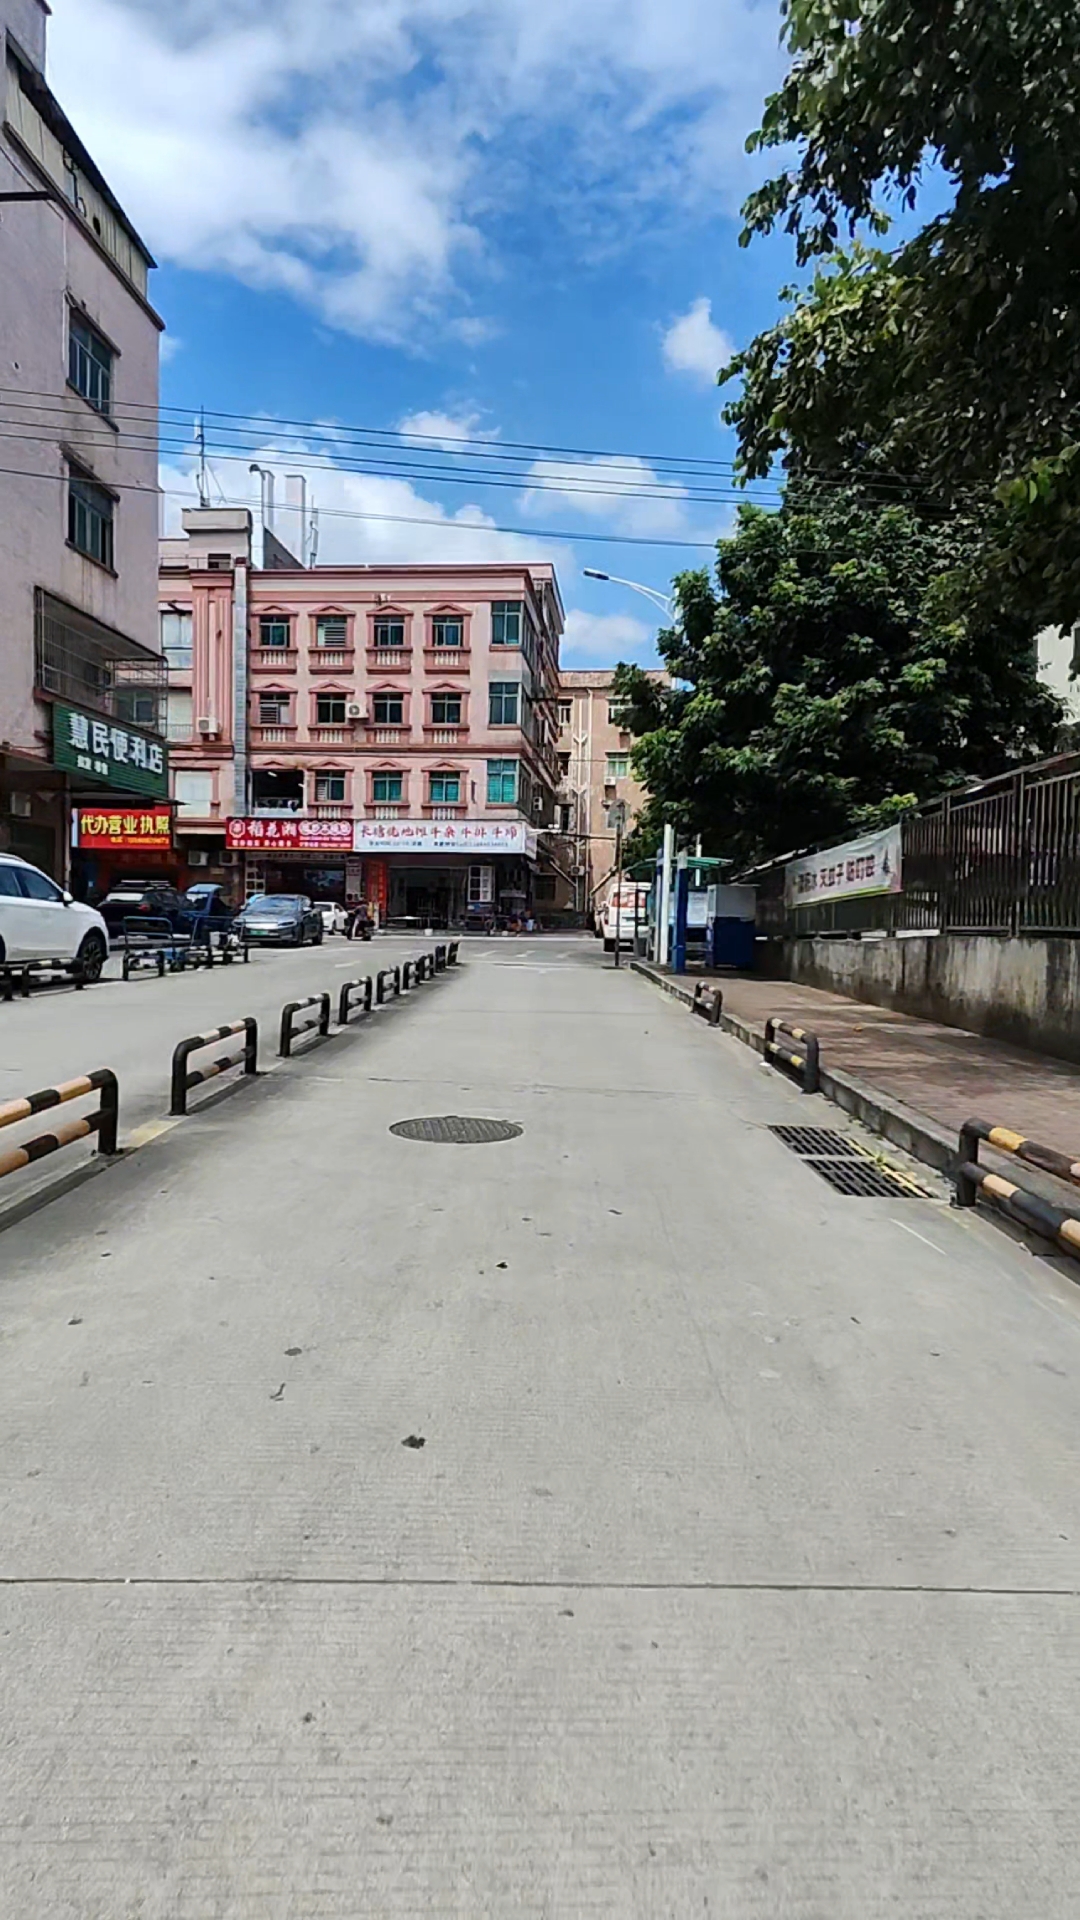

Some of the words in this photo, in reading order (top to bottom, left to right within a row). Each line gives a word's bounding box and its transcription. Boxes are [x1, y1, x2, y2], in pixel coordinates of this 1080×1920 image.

[81, 814, 170, 834] 代办营业执照
